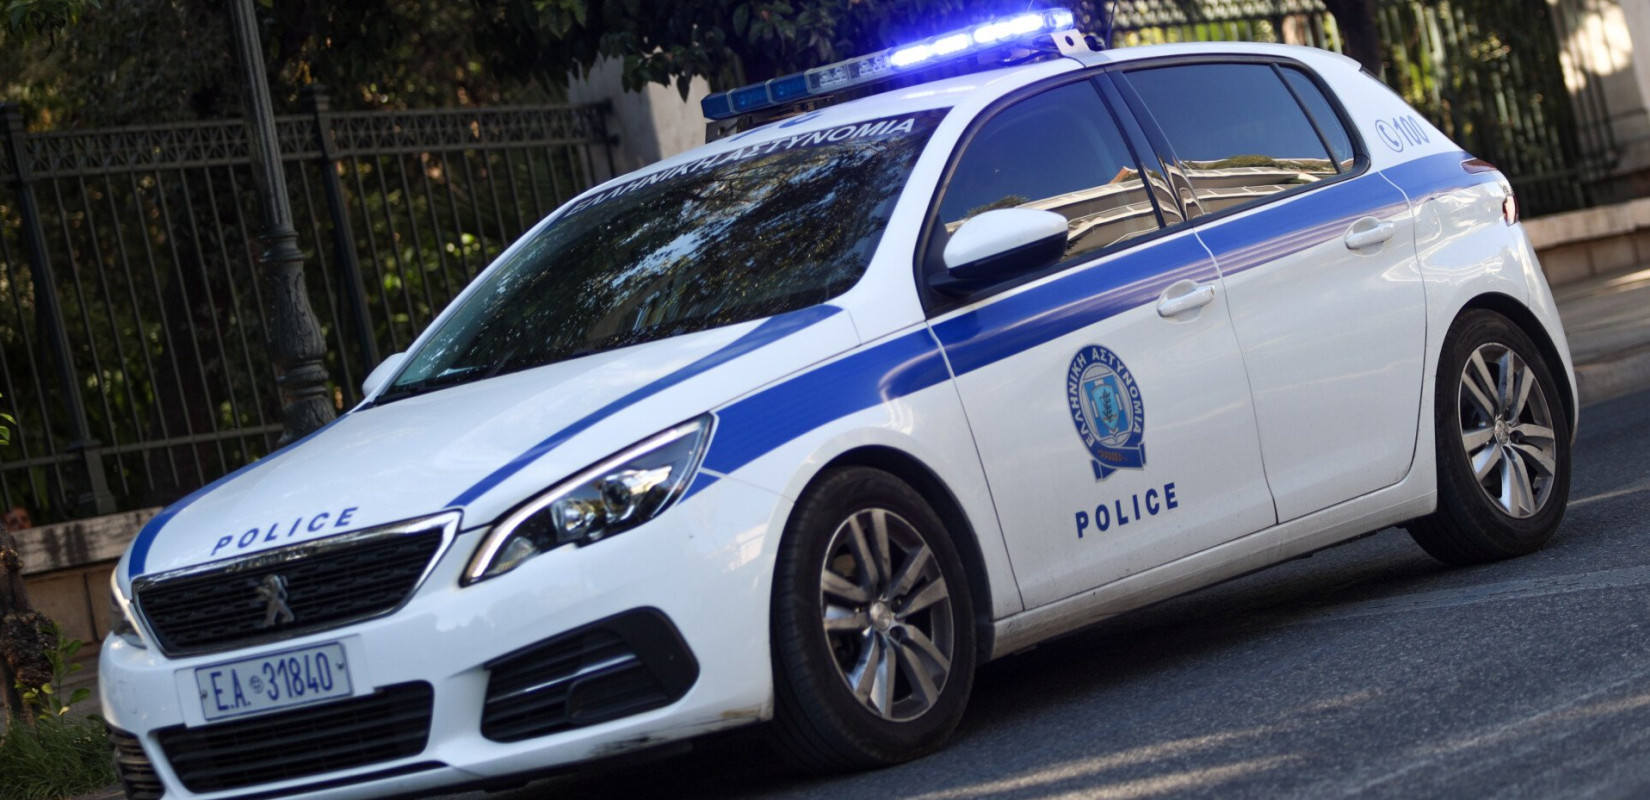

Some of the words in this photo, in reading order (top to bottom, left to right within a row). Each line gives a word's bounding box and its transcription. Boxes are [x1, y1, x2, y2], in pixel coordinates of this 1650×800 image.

[717, 118, 915, 166] ΑΣΤΥΝΟΜΙΑ
[1392, 114, 1430, 146] 100
[1068, 353, 1095, 448] ΕΛΛΗΝΙΚΗ
[1092, 347, 1143, 434] ΑΣΤΥΝΟΜΙΑ
[210, 506, 359, 556] POLICE
[1075, 482, 1178, 539] POLICE
[262, 652, 333, 701] 31840
